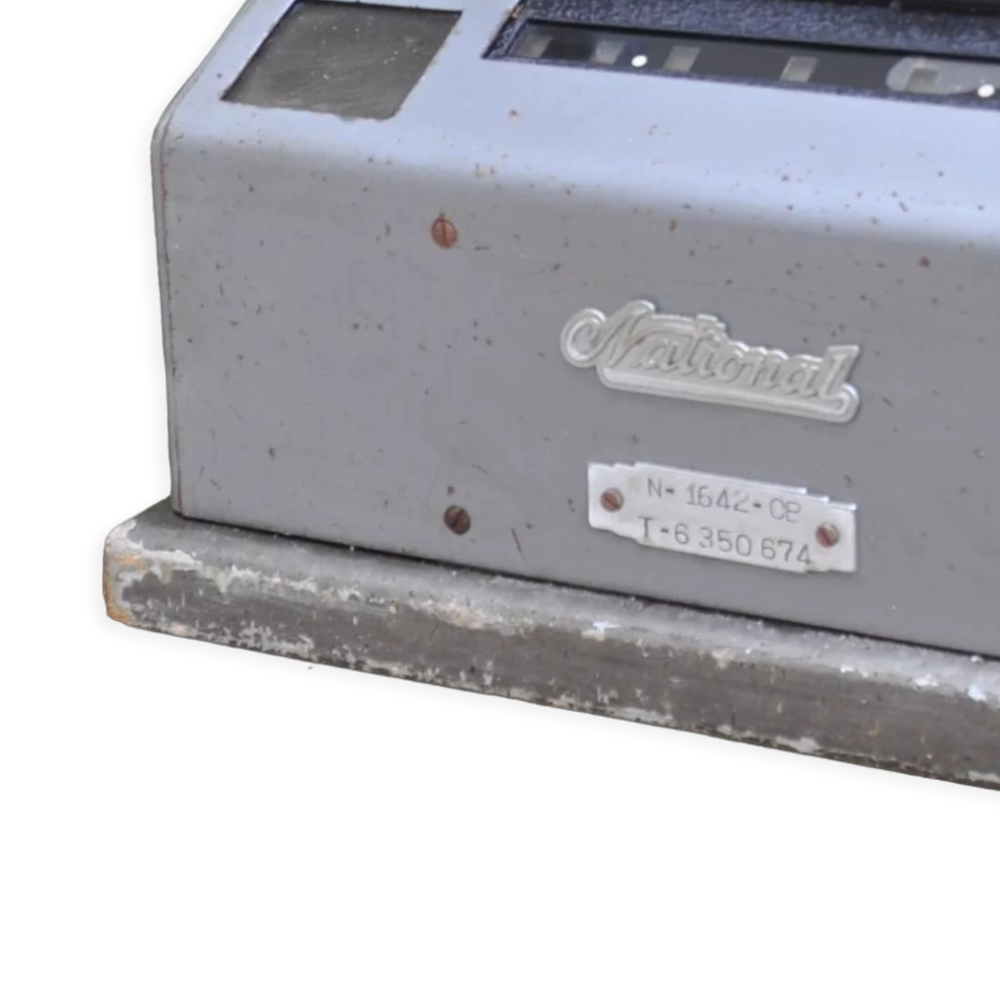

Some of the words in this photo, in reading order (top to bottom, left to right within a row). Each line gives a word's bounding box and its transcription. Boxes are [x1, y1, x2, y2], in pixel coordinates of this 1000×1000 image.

[562, 300, 859, 412] National
[698, 526, 753, 558] 350
[760, 537, 814, 566] 674
